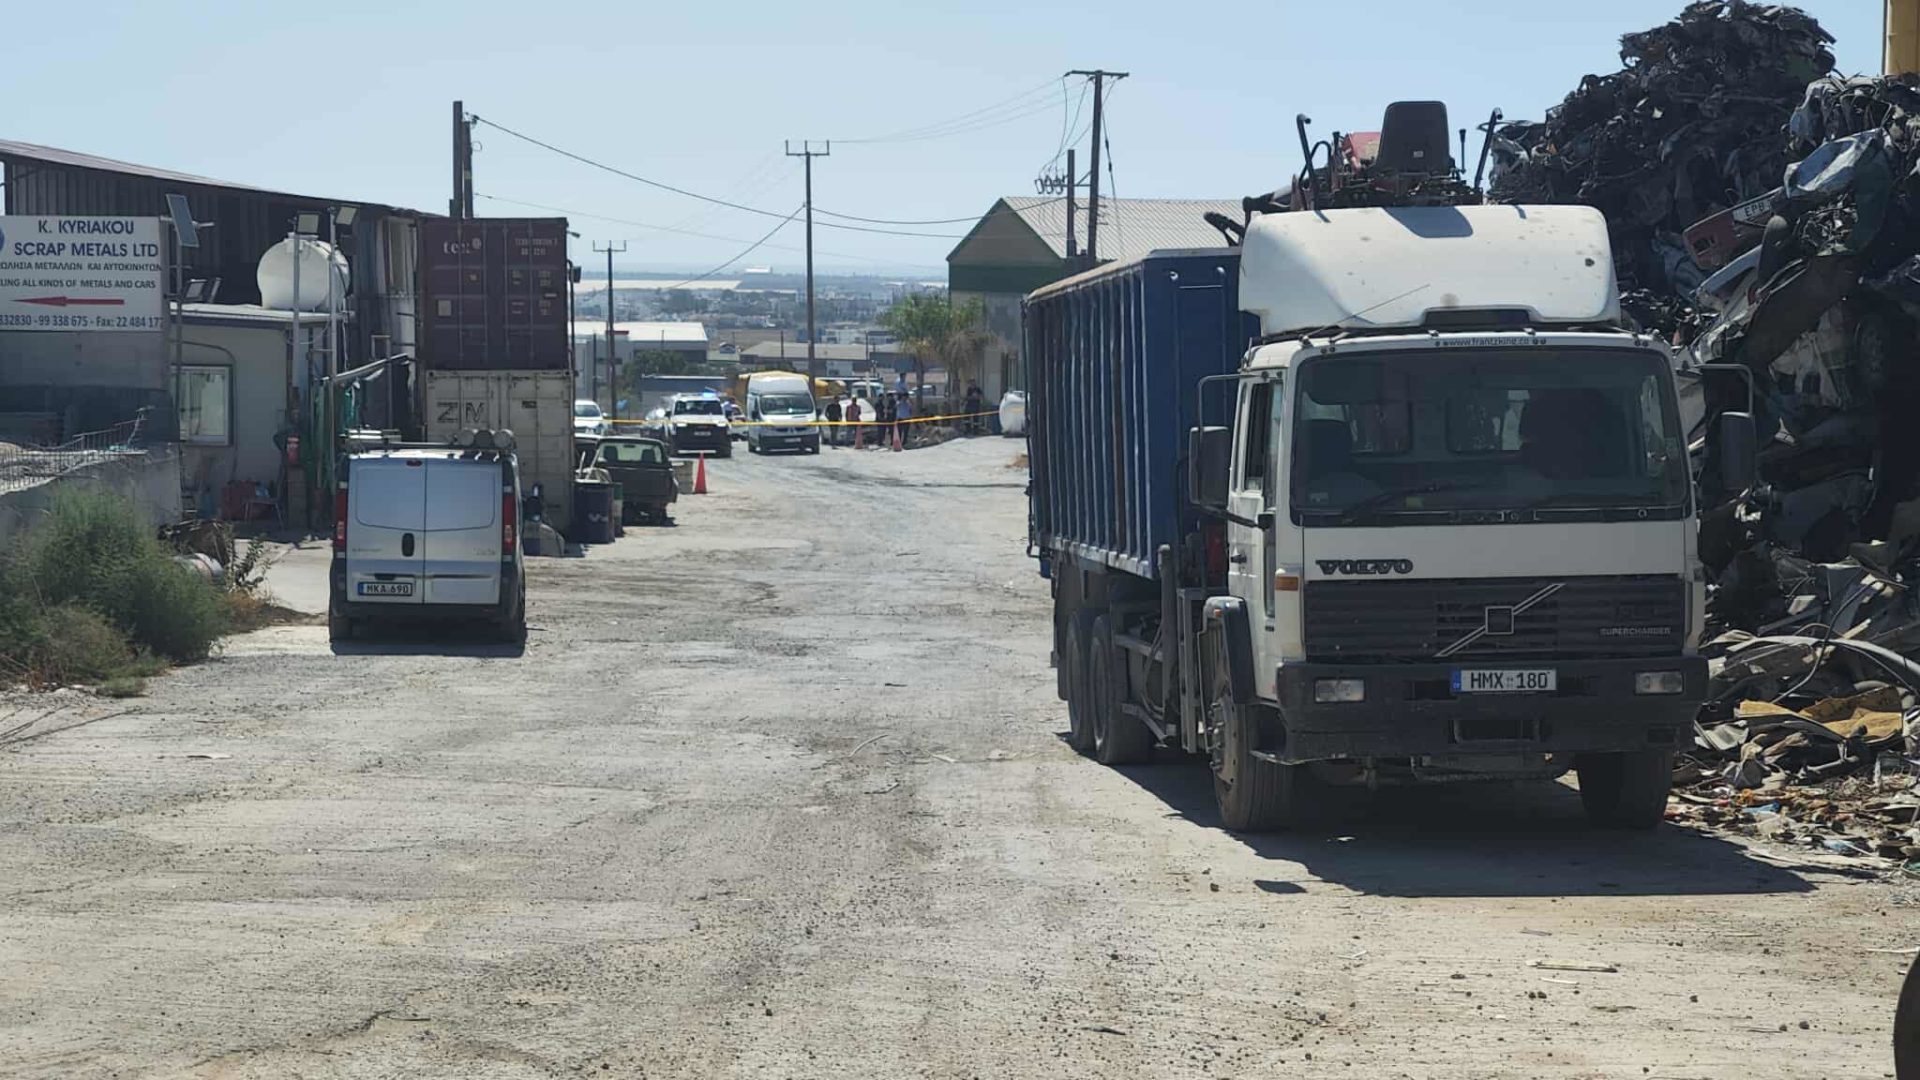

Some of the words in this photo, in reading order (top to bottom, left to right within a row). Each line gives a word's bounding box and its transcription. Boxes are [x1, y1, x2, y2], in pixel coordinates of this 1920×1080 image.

[38, 219, 53, 234] K.
[59, 219, 134, 234] KYRIAKOU
[14, 242, 66, 256] SCRAP
[71, 242, 128, 257] METALS
[133, 243, 159, 257] LTD
[22, 279, 38, 287] ALL
[38, 279, 64, 288] KINDS
[65, 279, 77, 287] OF
[80, 280, 113, 288] METALS
[114, 280, 133, 288] AND
[134, 280, 156, 288] CARS
[38, 314, 50, 326] 99
[71, 315, 88, 327] 675
[96, 316, 115, 327] Fax:
[116, 316, 128, 327] 22
[129, 316, 146, 327] 484
[1315, 559, 1413, 575] VOLVO
[1470, 672, 1504, 689] HMX
[1516, 672, 1548, 689] 180
